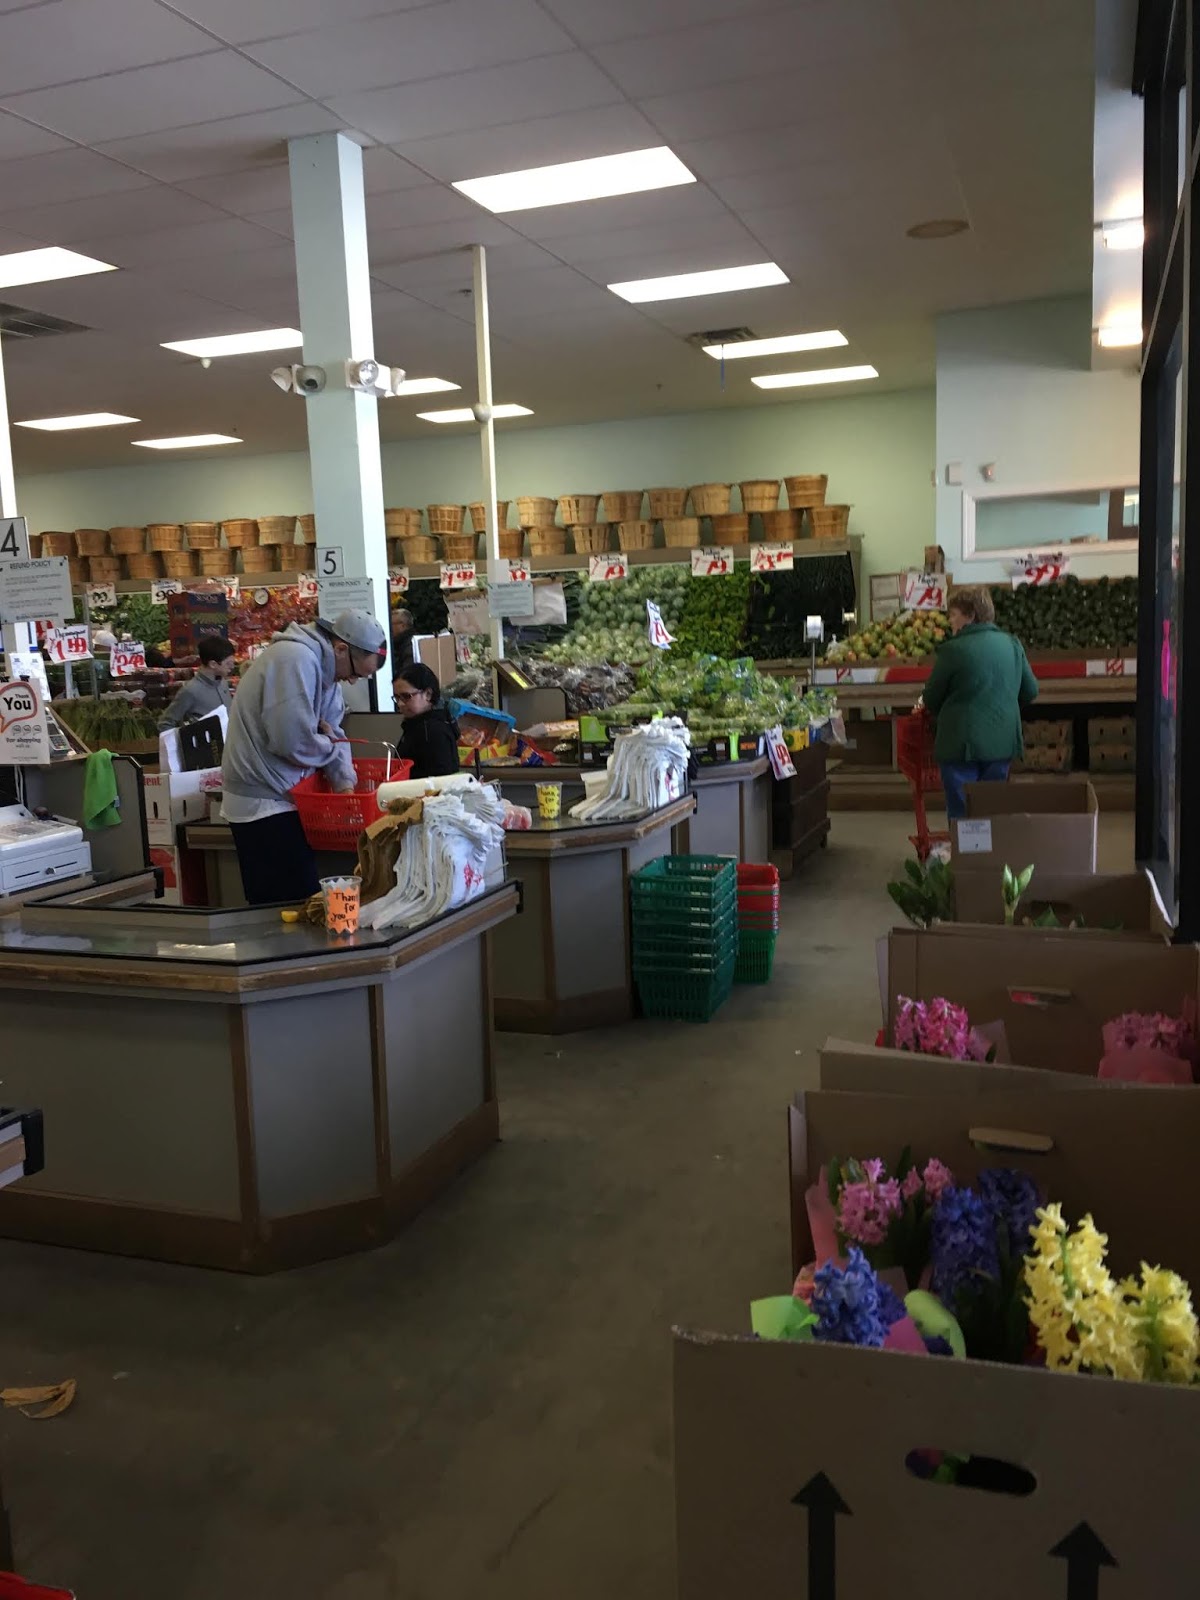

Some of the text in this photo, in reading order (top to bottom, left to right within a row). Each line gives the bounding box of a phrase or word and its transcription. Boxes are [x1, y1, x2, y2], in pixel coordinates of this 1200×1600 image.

[0, 522, 20, 557] 4
[31, 560, 51, 568] POLICY
[323, 551, 337, 575] 5
[3, 697, 32, 711] You
[344, 903, 356, 913] for
[331, 913, 346, 921] you
